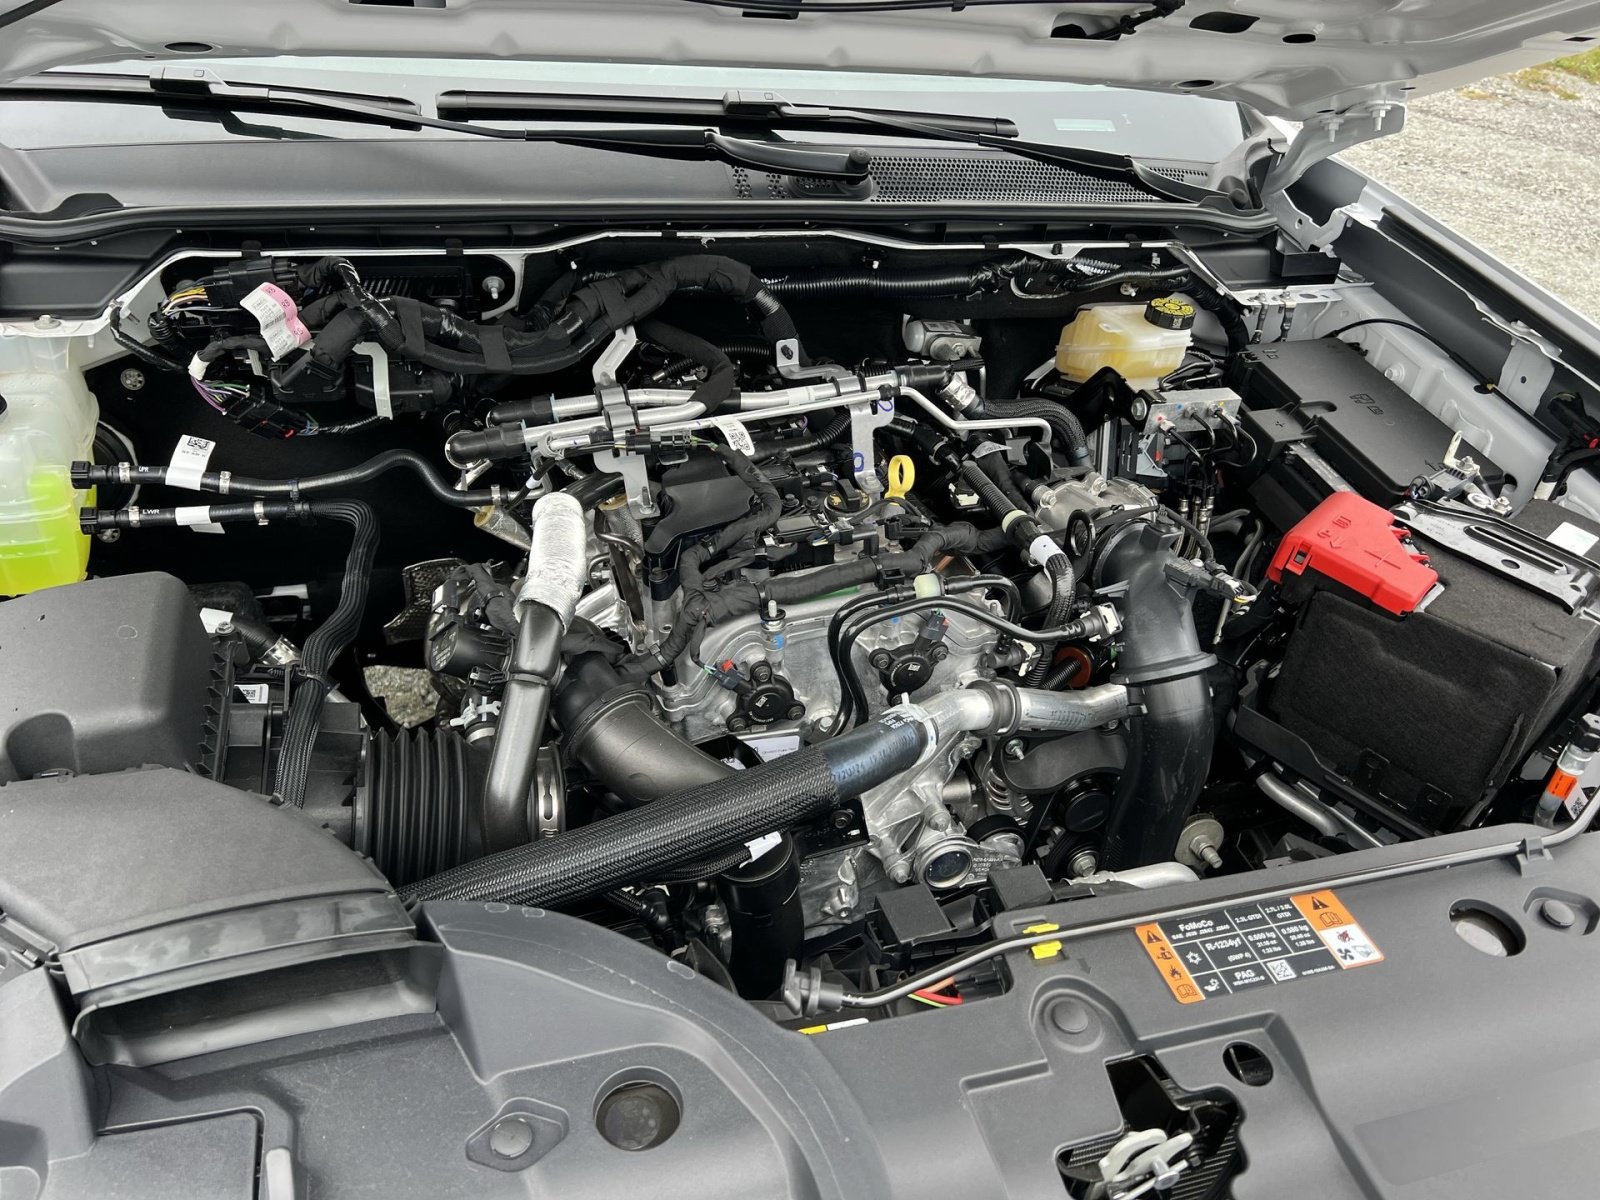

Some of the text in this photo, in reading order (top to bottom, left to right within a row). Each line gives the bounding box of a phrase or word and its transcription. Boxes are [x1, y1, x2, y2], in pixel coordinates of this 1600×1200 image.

[1178, 920, 1214, 932] FoMoCo
[1266, 931, 1276, 939] kg
[1205, 937, 1242, 951] R-1234yf
[1234, 969, 1256, 980] PAG
